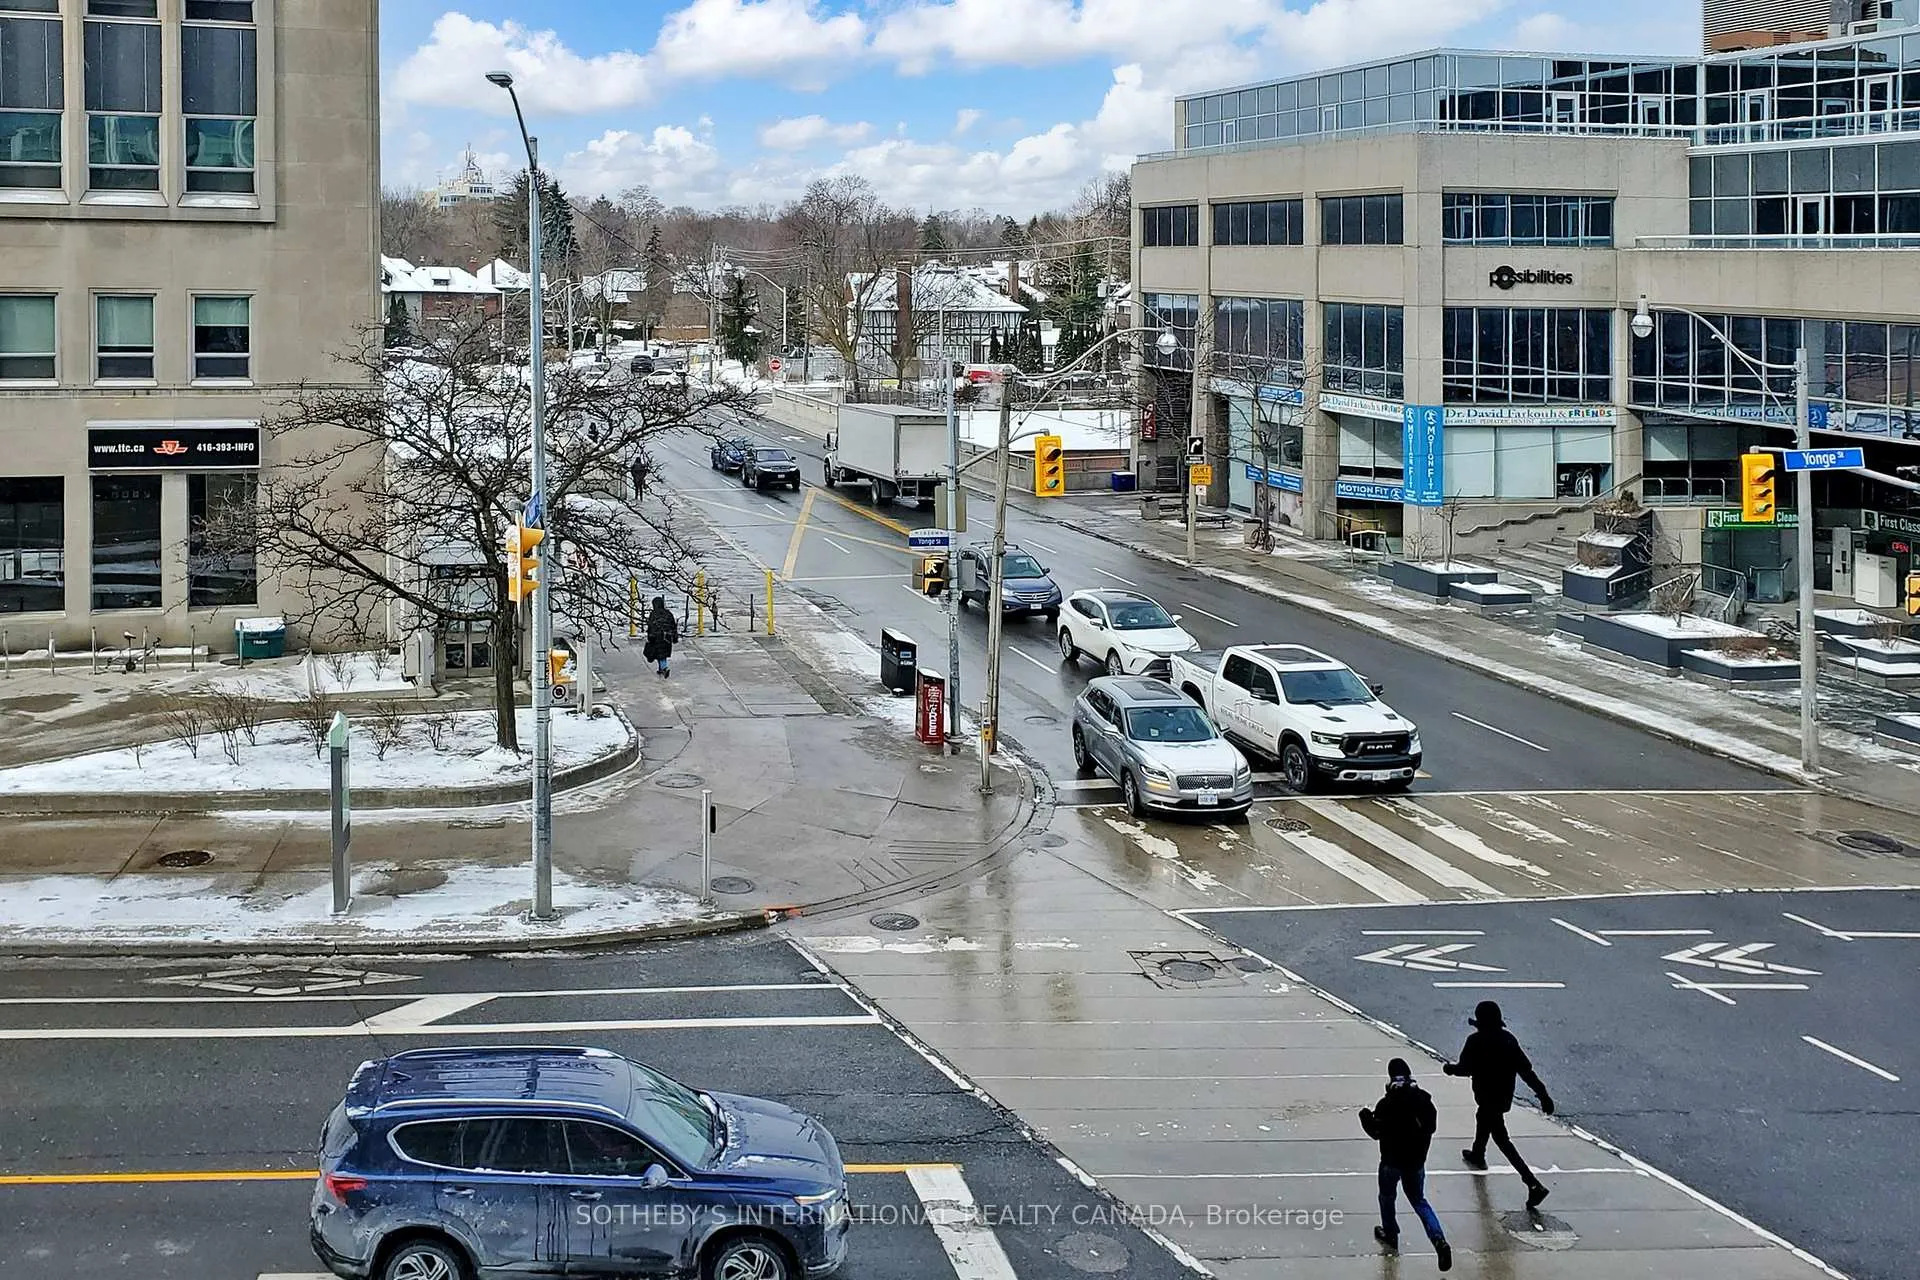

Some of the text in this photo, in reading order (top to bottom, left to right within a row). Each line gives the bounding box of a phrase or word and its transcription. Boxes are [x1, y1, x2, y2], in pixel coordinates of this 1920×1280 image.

[1489, 265, 1574, 290] possibilities
[1446, 408, 1464, 418] Dr.
[1467, 408, 1503, 418] David
[1568, 406, 1613, 418] FRIENDS
[94, 442, 254, 453] www.ttc.ca 416-393-INFO
[1427, 426, 1436, 466] MOTION
[1801, 452, 1836, 468] Yonge
[1338, 483, 1389, 495] MOTION FIT
[1723, 511, 1740, 522] First
[1776, 511, 1799, 522] Clean
[1880, 514, 1899, 530] First
[917, 538, 935, 546] Yonge
